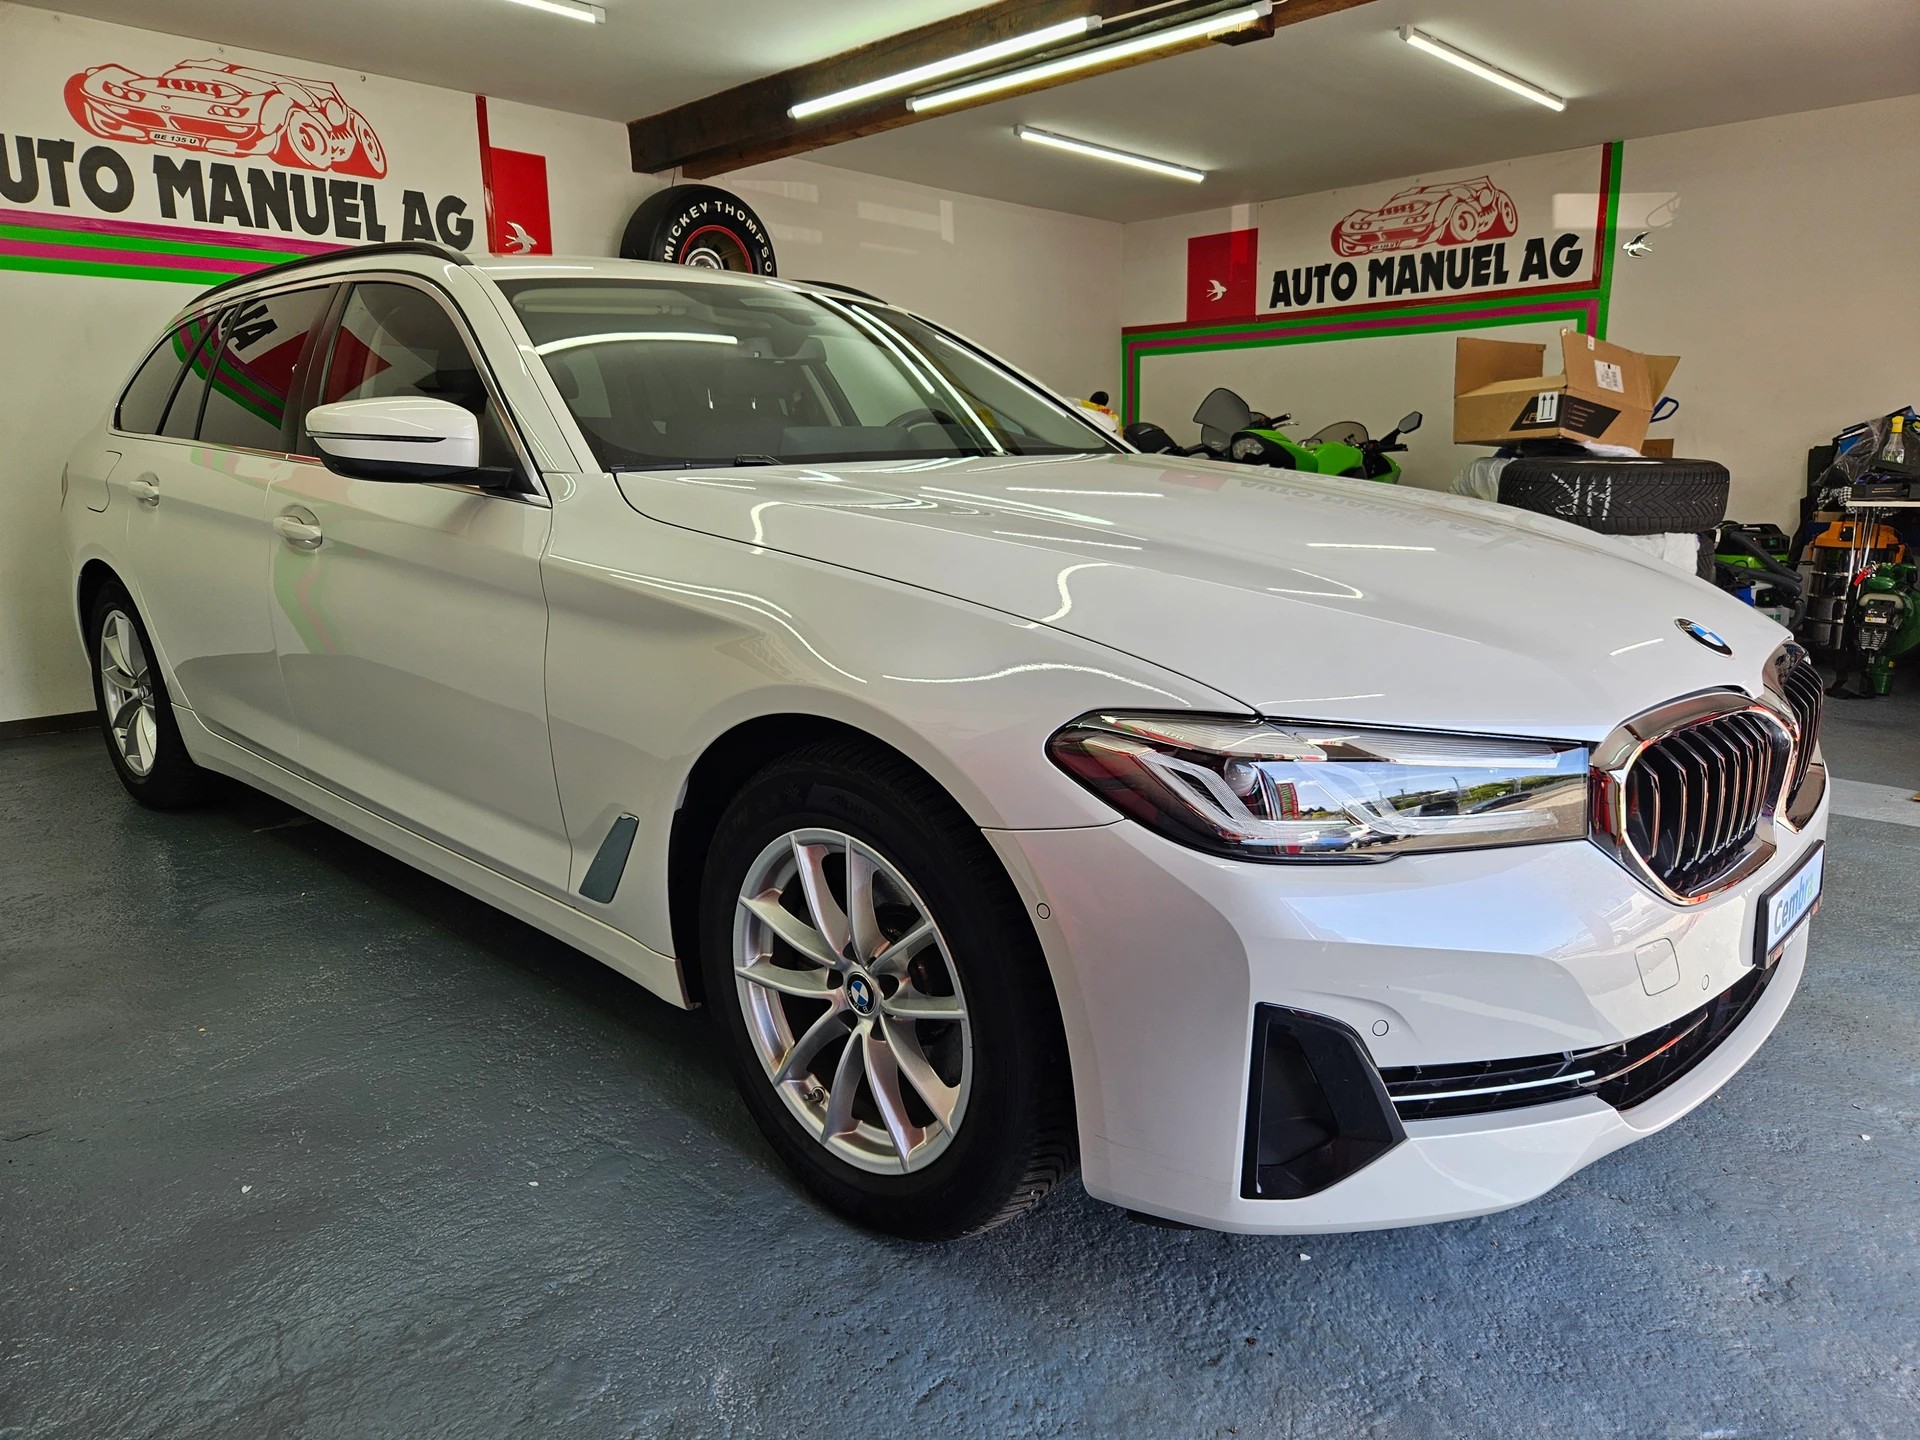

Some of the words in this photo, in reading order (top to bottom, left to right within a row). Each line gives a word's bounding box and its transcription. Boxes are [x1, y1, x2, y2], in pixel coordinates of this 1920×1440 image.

[0, 133, 134, 213] UTO
[153, 154, 386, 243] MANUEL
[401, 190, 474, 251] AG
[664, 202, 708, 261] MICKEY
[715, 201, 772, 272] THOMPSO
[1269, 261, 1357, 309] AUTO
[1367, 243, 1509, 298] MANUEL
[1518, 233, 1583, 282] AG
